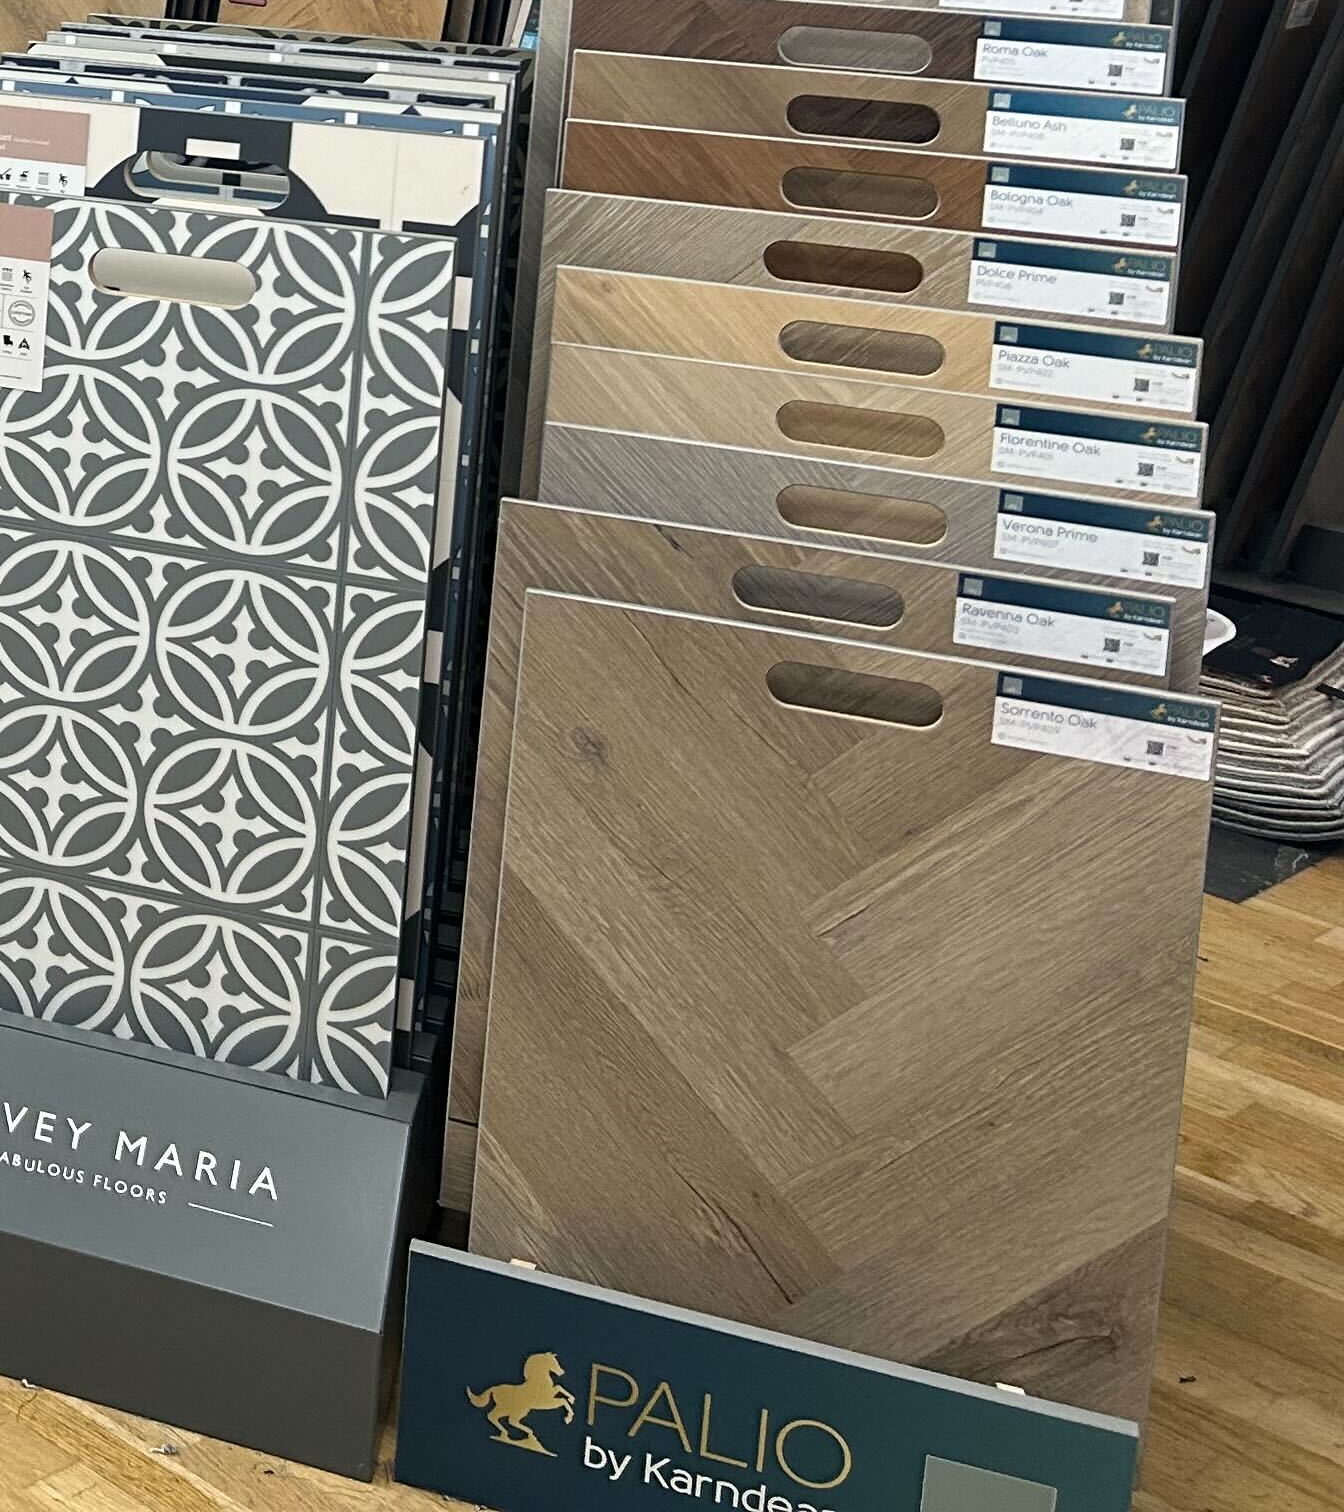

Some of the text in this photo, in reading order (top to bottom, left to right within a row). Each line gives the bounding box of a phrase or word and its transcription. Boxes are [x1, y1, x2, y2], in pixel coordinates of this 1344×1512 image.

[983, 44, 1048, 57] Roma Oak
[992, 116, 1066, 131] Belluno Ash
[991, 191, 1073, 207] Bologna Oak
[977, 266, 1057, 284] Dolce Prime
[999, 351, 1070, 369] Piazza Oak
[1000, 433, 1069, 451] Florentine
[1072, 443, 1101, 456] Oak
[1003, 520, 1053, 536] Verona
[1057, 527, 1098, 542] Prime
[962, 604, 1023, 622] Ravenna
[1026, 614, 1055, 627] Oak
[1001, 703, 1096, 728] Sorrento Oak
[114, 1129, 280, 1201] MARIA
[92, 1174, 168, 1206] FLOORS
[587, 1363, 853, 1489] PALIO
[583, 1435, 840, 1512] by Karnde
